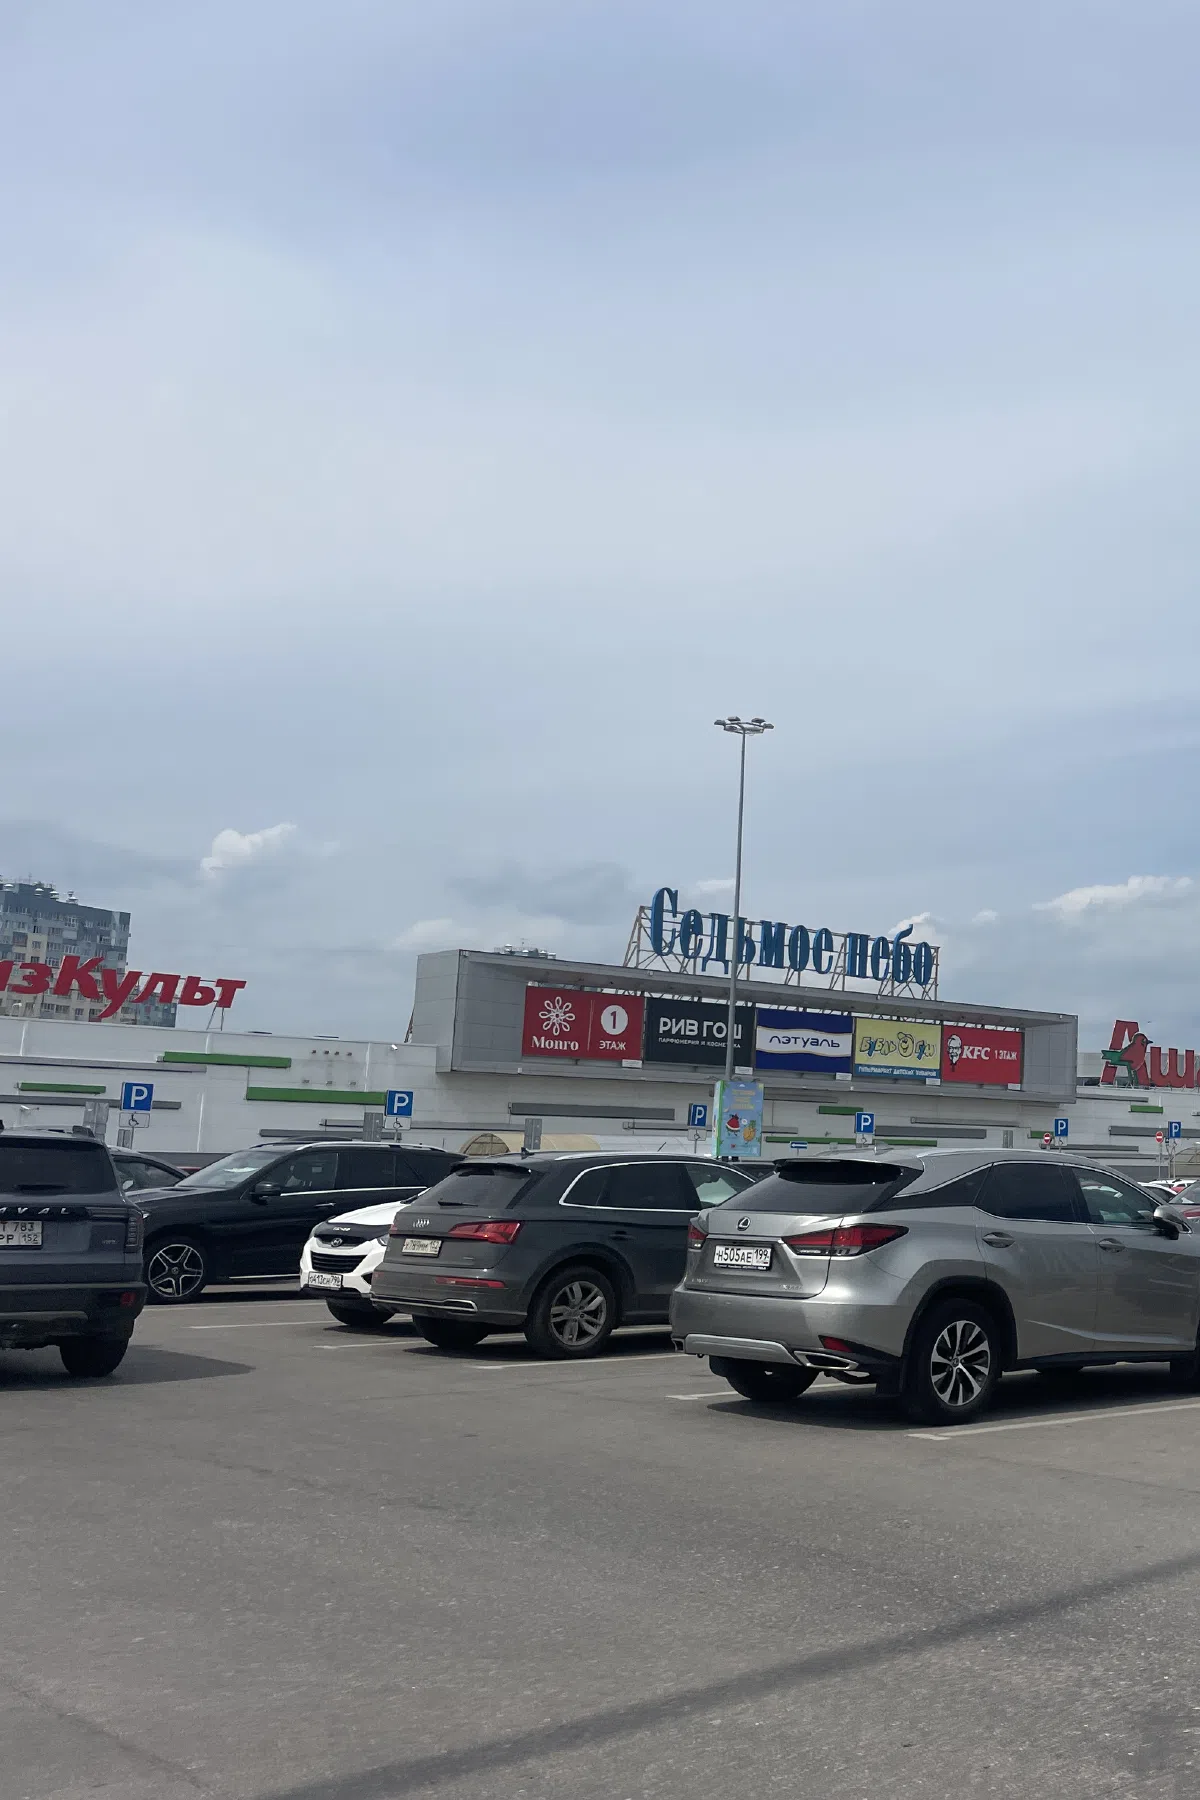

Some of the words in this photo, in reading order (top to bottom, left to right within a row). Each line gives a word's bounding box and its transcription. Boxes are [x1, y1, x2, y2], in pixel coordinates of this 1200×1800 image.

[650, 887, 834, 975] Седьмое
[847, 923, 933, 986] небо
[0, 955, 248, 1019] зКульт
[607, 1010, 617, 1030] 1
[659, 1017, 699, 1036] РИВ
[702, 1021, 742, 1039] ГОШ
[599, 1040, 627, 1051] ЭТАЖ
[962, 1045, 991, 1060] KFC
[998, 1050, 1018, 1060] ЭТАЖ
[131, 1085, 148, 1108] P
[393, 1093, 409, 1114] P
[694, 1106, 705, 1125] P
[861, 1115, 871, 1131] P
[1058, 1120, 1066, 1135] P
[1172, 1122, 1180, 1137] P
[13, 1222, 35, 1232] 783
